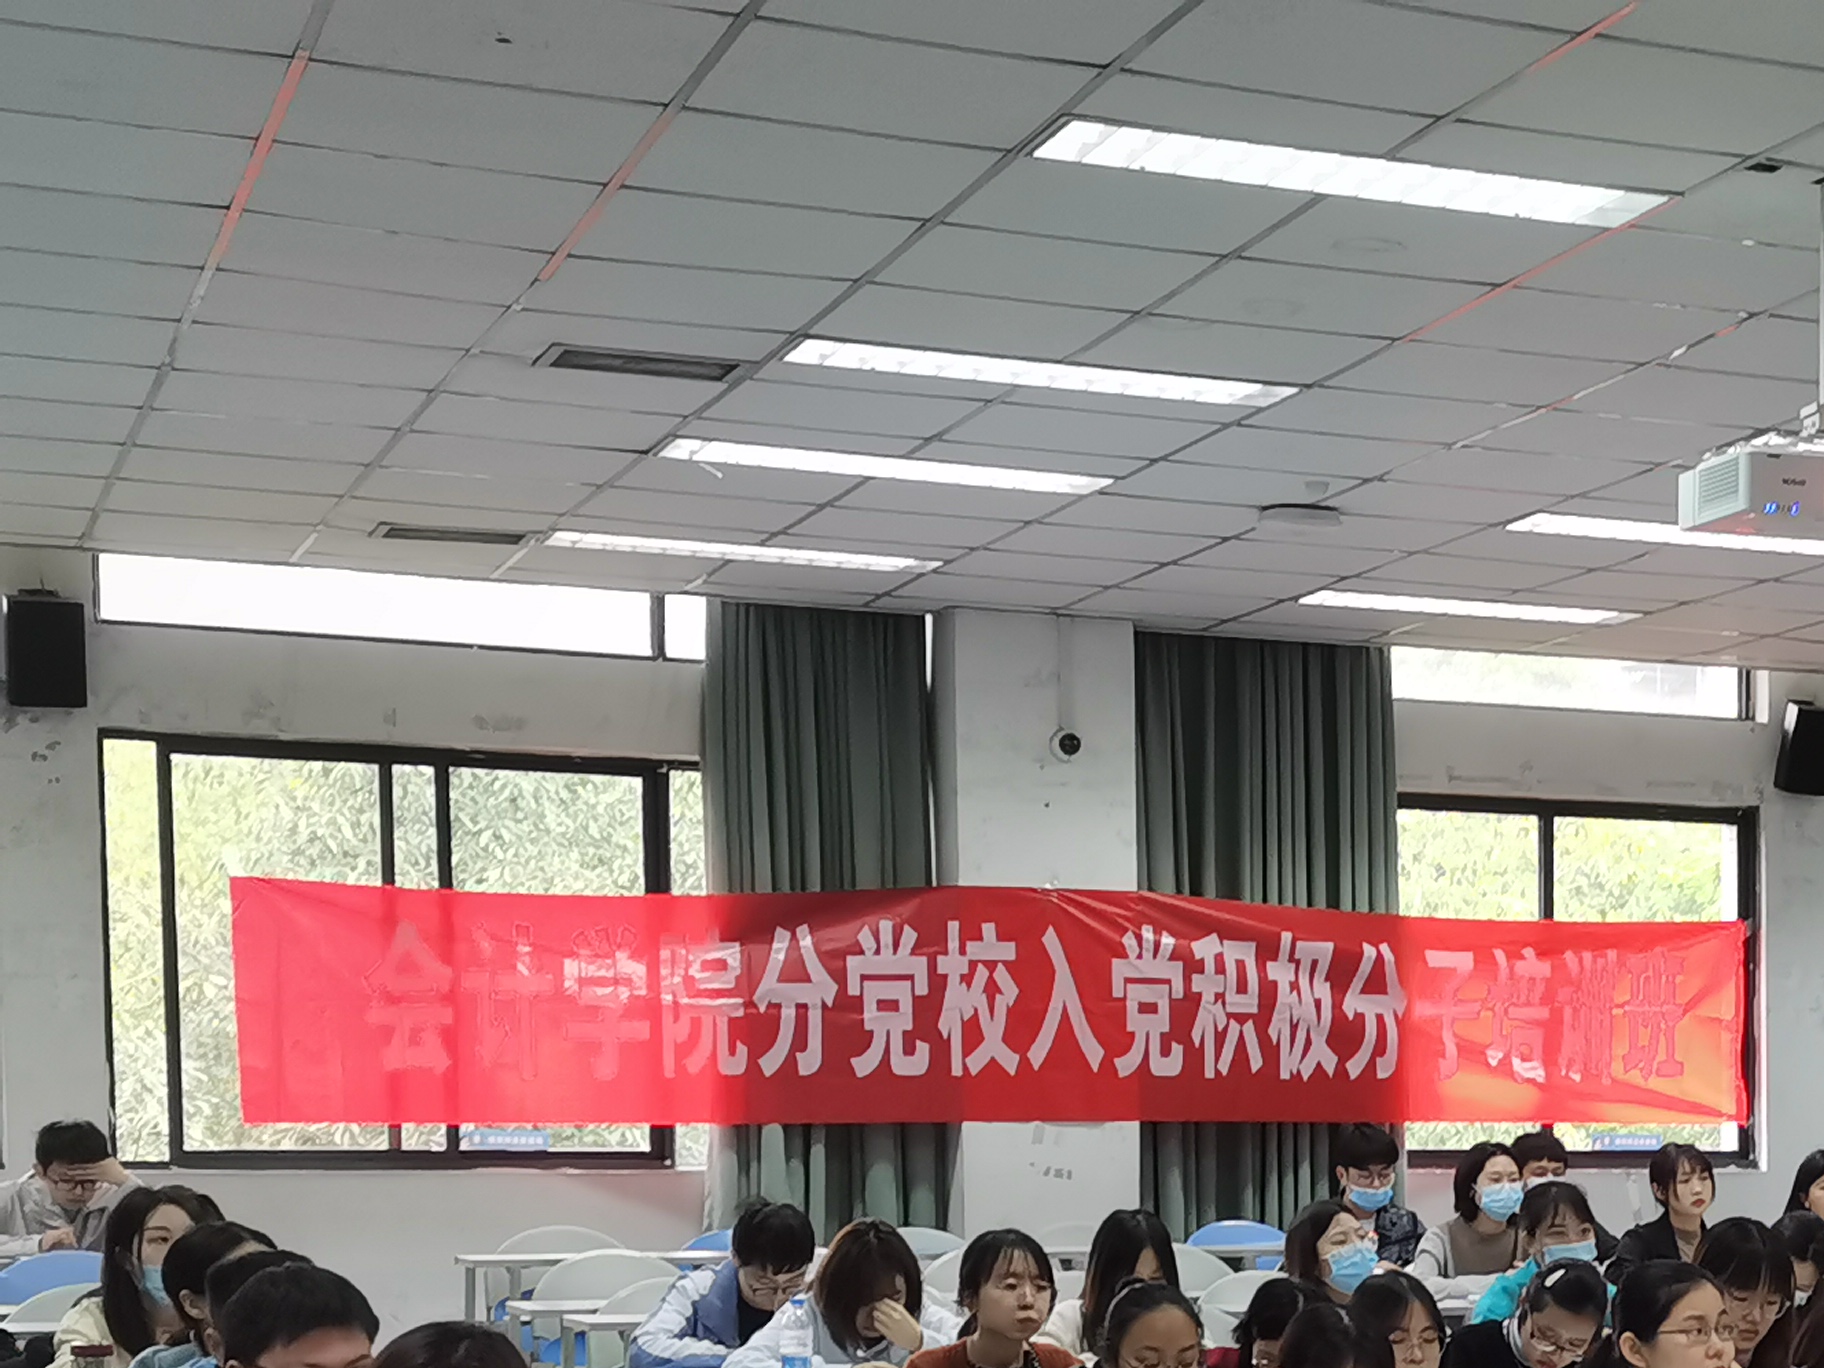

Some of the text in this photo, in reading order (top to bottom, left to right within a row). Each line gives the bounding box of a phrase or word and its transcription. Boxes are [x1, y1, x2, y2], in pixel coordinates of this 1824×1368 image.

[362, 916, 1685, 1084] 会计学院分党校入党积极分子培训班
